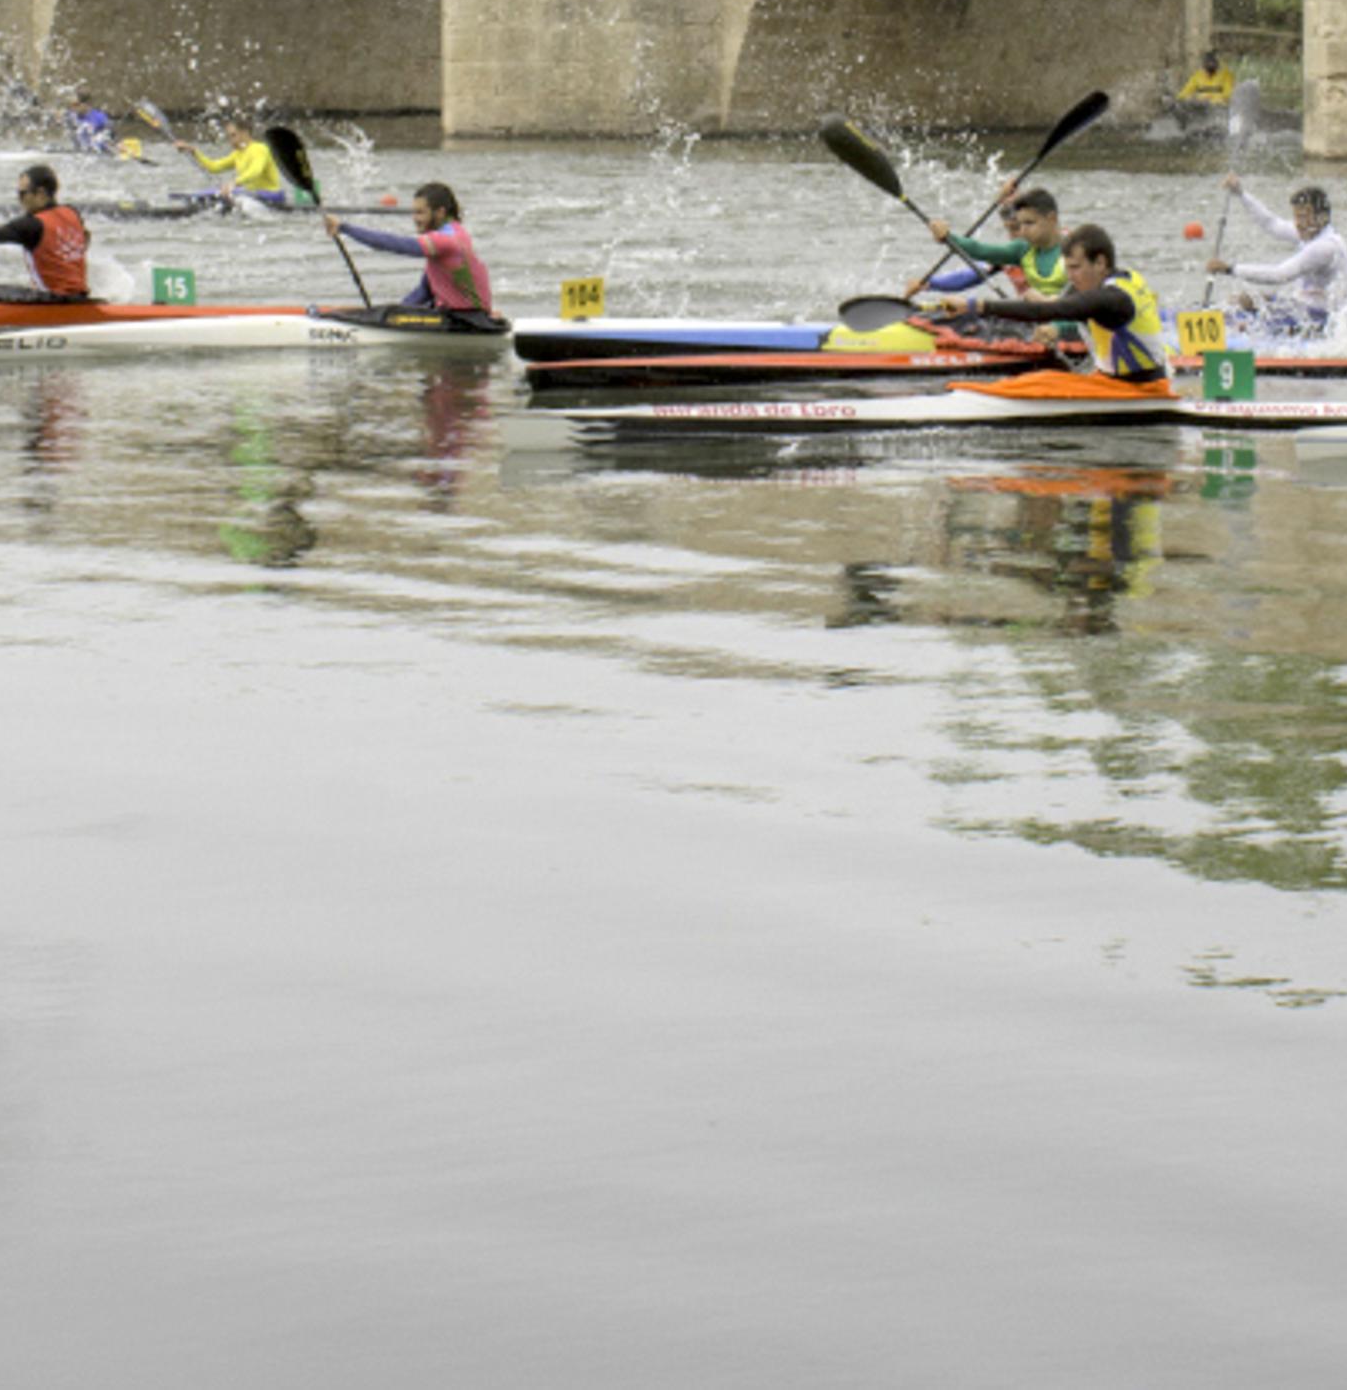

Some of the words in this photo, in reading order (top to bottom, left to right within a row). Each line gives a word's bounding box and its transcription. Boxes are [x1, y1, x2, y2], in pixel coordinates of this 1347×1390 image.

[164, 276, 188, 299] 15
[566, 283, 600, 309] 104
[1184, 317, 1220, 343] 110
[1218, 360, 1235, 390] 9
[799, 403, 857, 418] Ebro
